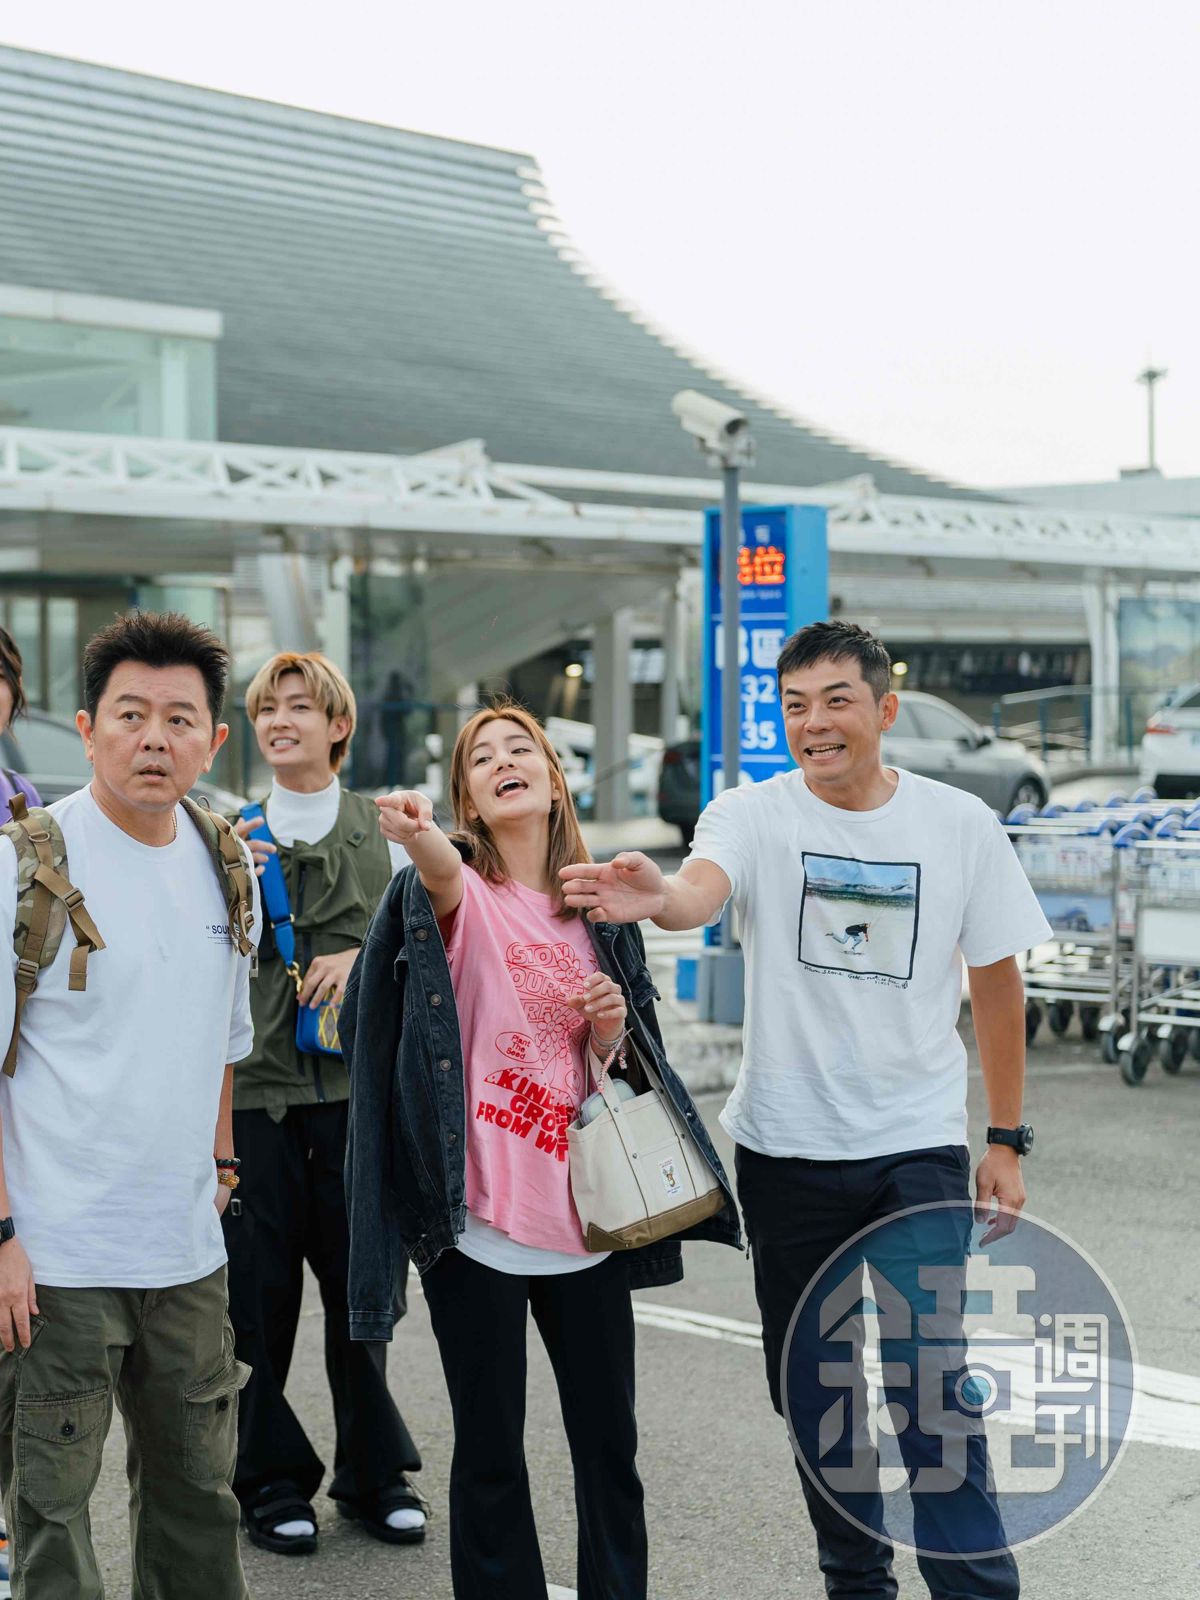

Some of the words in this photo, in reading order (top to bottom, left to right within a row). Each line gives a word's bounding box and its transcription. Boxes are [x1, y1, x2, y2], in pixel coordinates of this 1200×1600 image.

[511, 1034, 531, 1047] Plant
[512, 1042, 526, 1053] The
[505, 1048, 526, 1060] Seed
[476, 1101, 534, 1139] FROM
